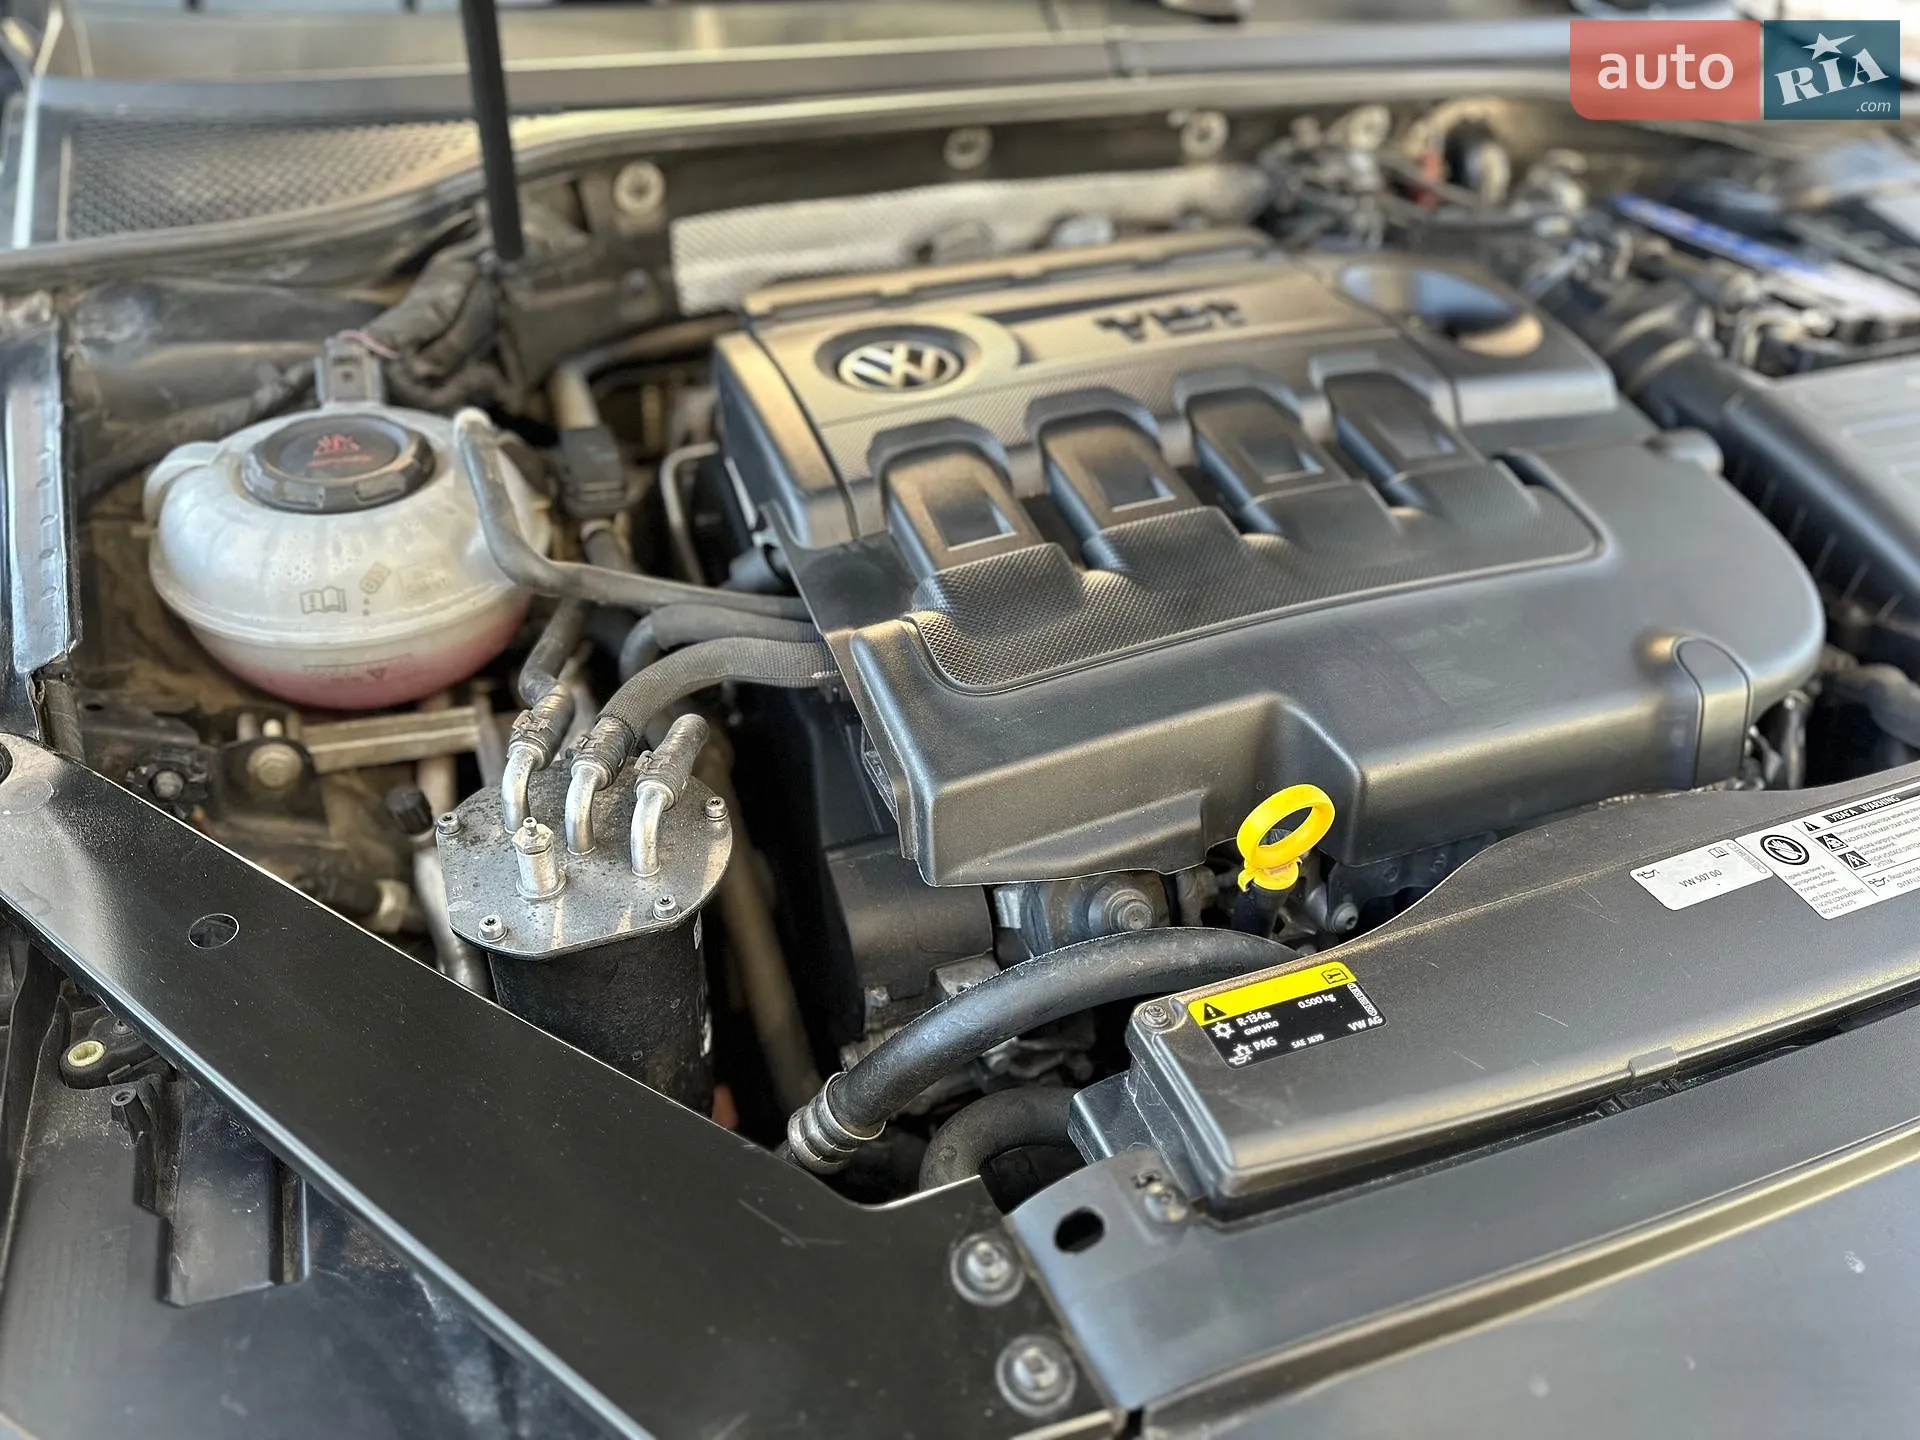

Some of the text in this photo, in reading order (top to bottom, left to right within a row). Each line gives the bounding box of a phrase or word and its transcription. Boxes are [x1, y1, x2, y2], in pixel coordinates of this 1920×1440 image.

[1829, 796, 1901, 821] УВАГА WARNING
[1679, 869, 1722, 888] VW 507 00
[1298, 993, 1337, 1009] 0.500 kg
[1236, 1011, 1272, 1027] R-134a
[1347, 1015, 1384, 1031] VW AG
[1244, 1025, 1262, 1036] GWP
[1252, 1036, 1278, 1051] PAG
[1291, 1039, 1307, 1049] SAE
